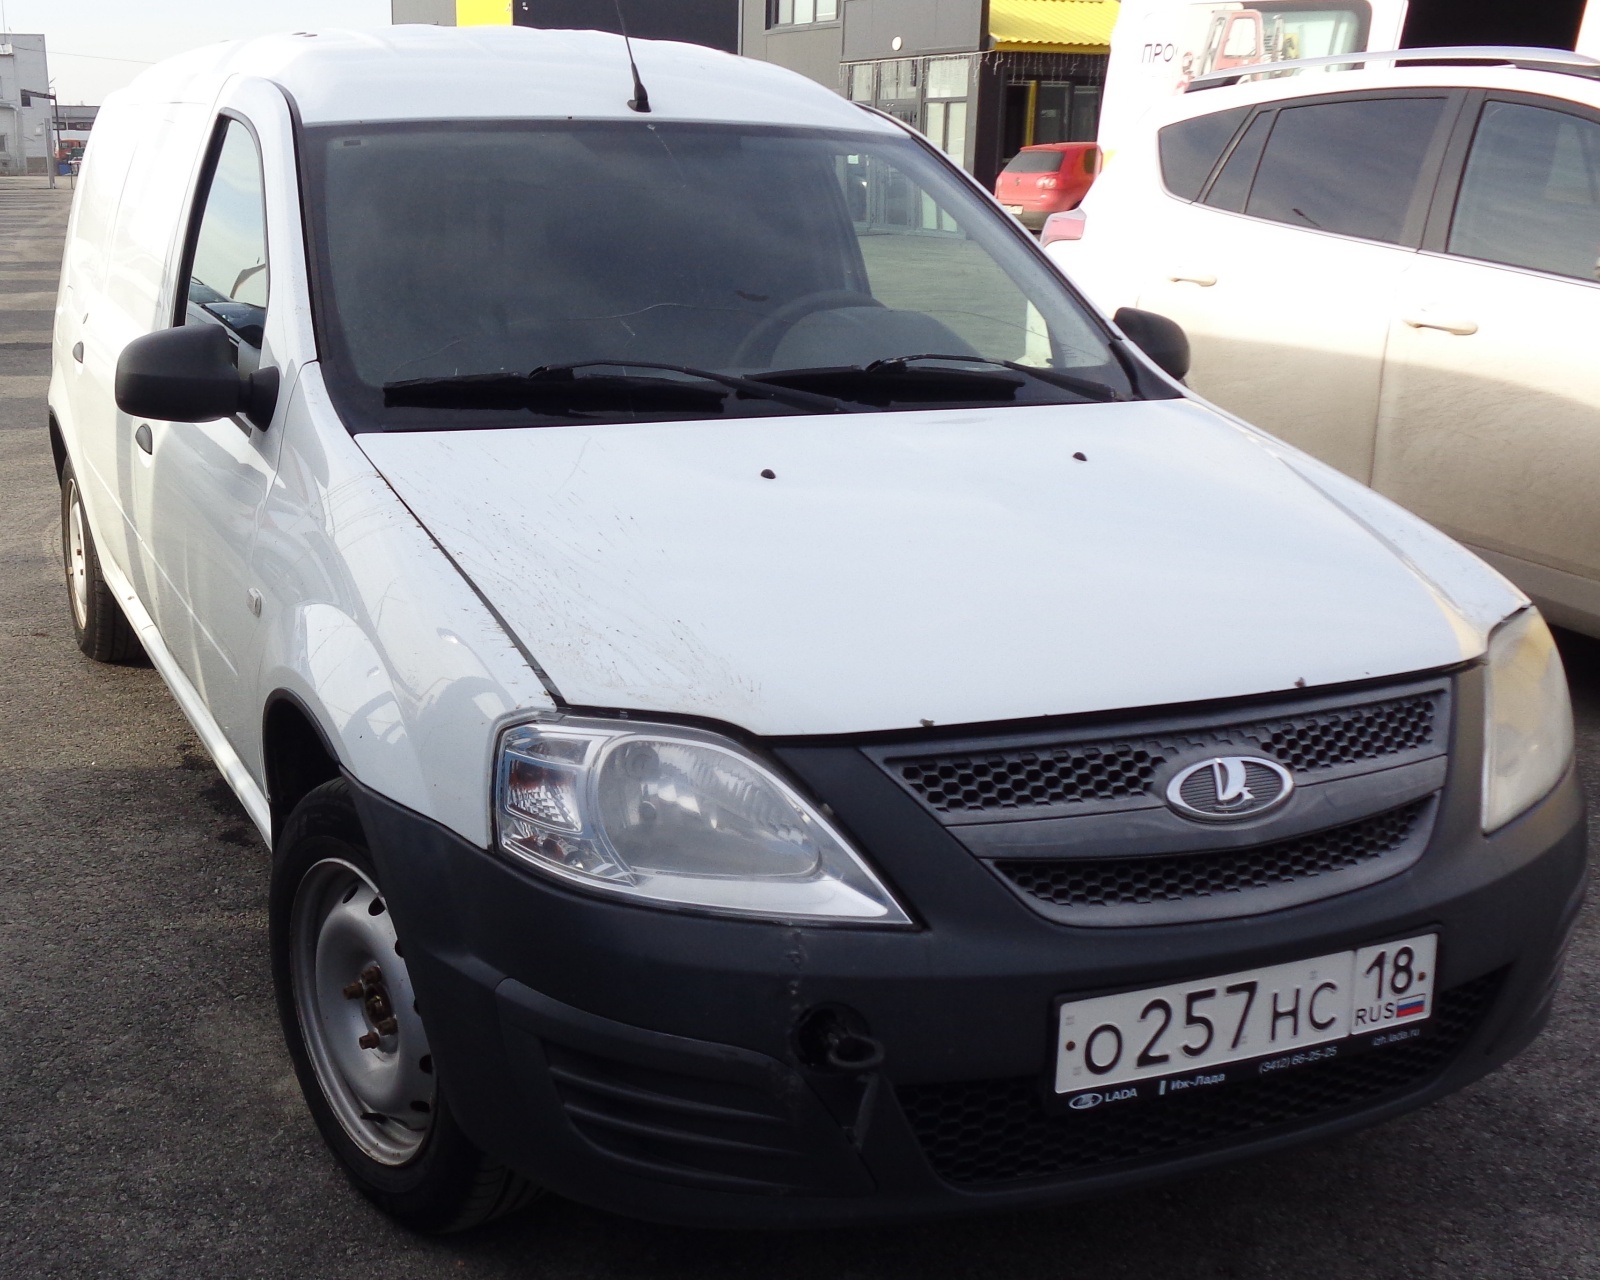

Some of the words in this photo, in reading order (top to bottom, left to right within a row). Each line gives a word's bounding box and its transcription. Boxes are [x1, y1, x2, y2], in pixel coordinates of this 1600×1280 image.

[1141, 43, 1178, 63] ПРО
[1366, 946, 1413, 999] 18
[1355, 1002, 1395, 1027] RUS
[1171, 1072, 1226, 1091] Иж-Лада
[1105, 1087, 1138, 1103] LADA
